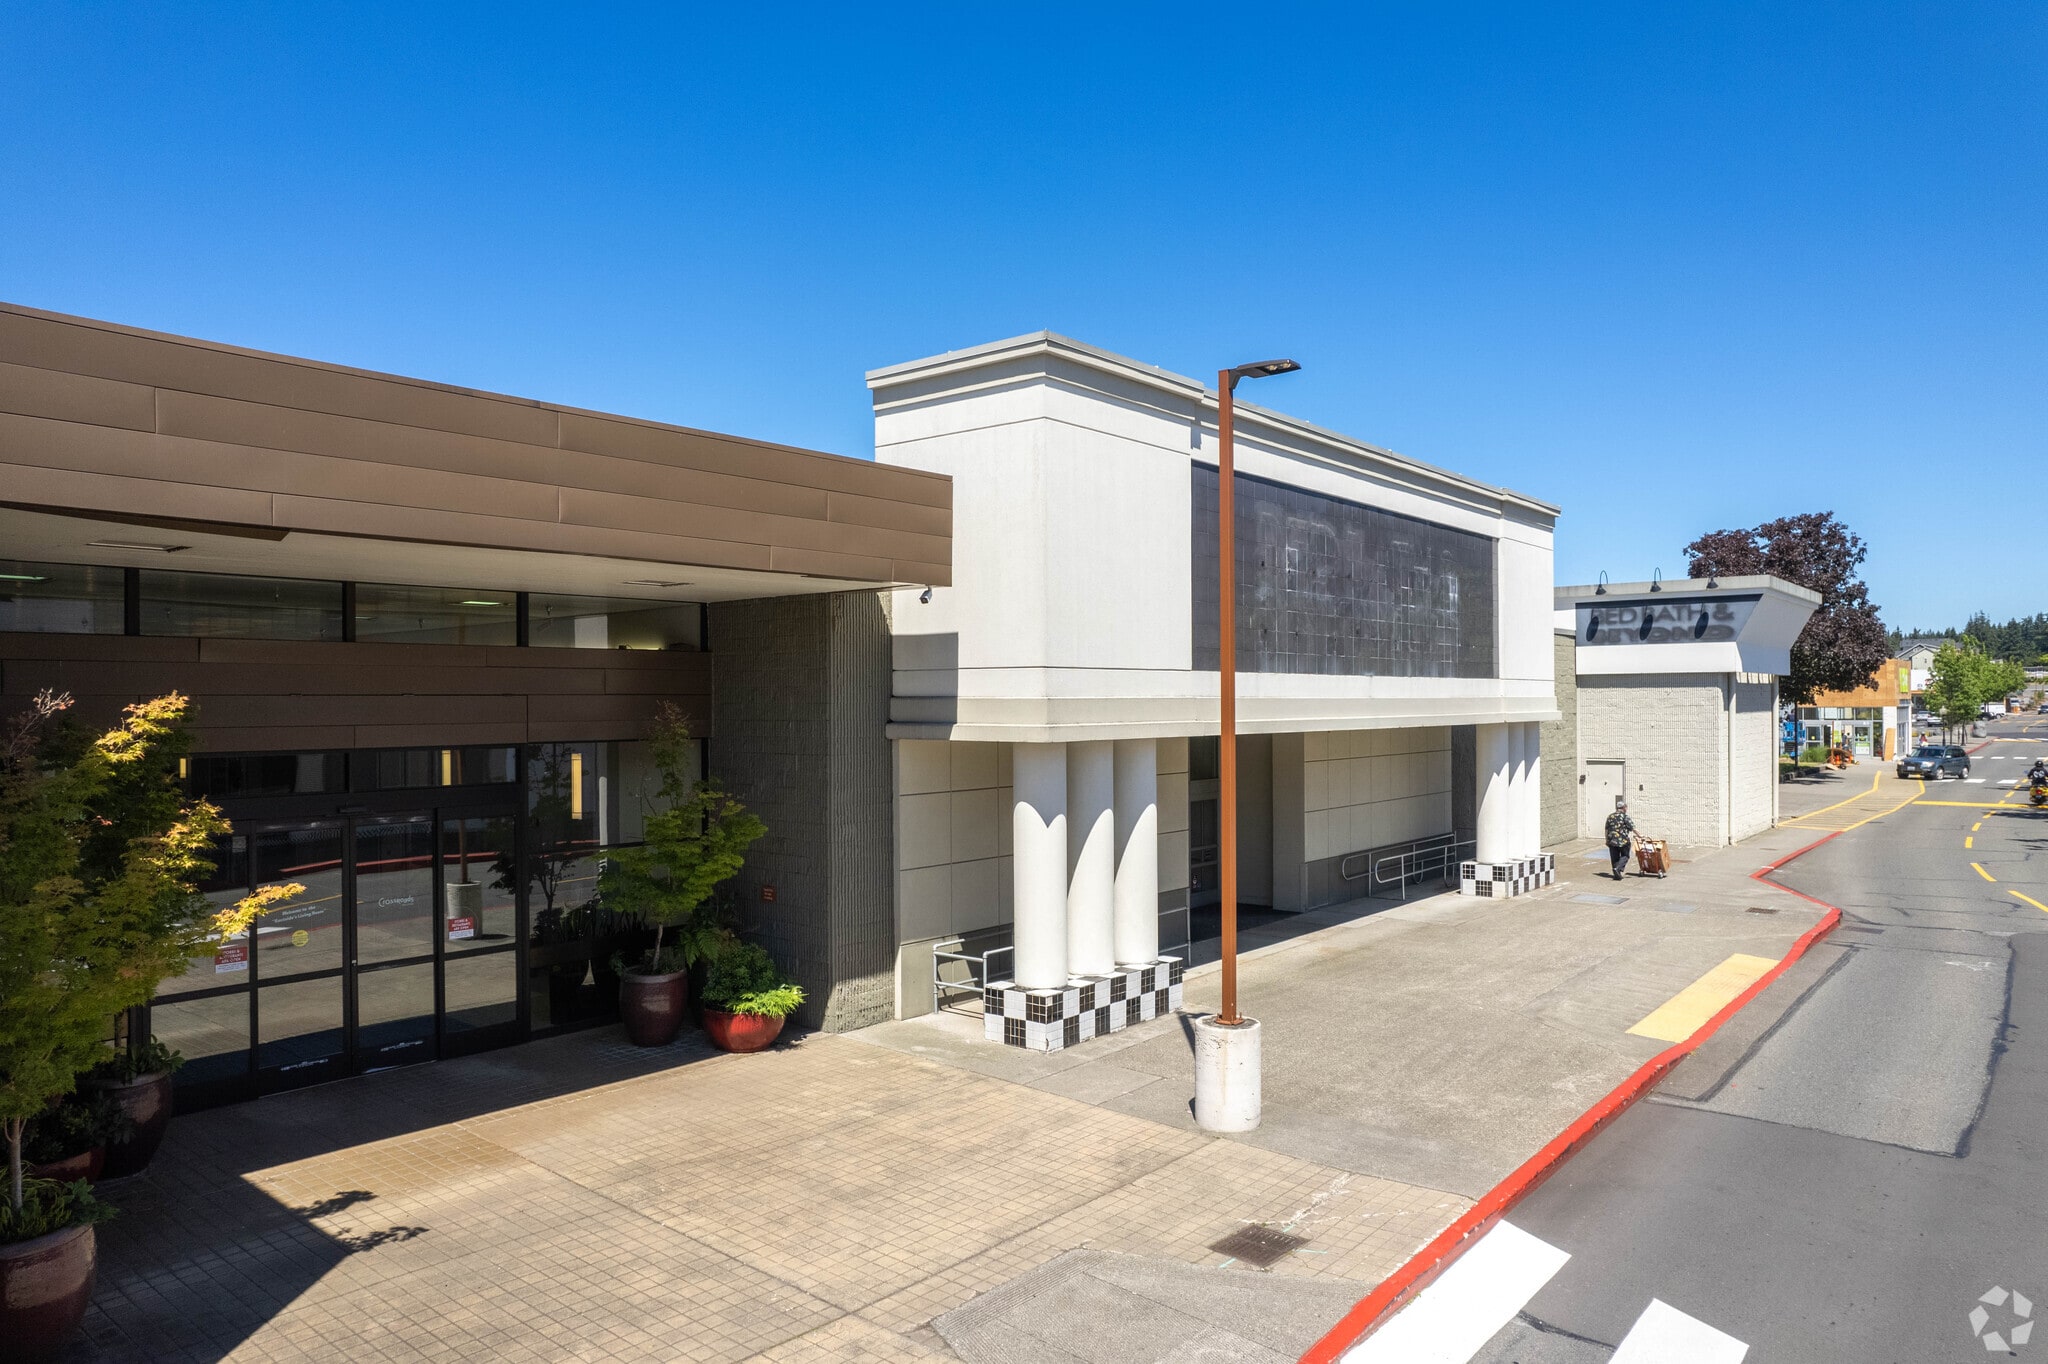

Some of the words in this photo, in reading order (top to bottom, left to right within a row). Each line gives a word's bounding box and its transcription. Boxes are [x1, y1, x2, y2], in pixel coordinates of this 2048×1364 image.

[1592, 607, 1637, 625] BED
[1641, 603, 1703, 623] BATH
[1712, 603, 1735, 621] &
[1591, 624, 1735, 644] BEYOND
